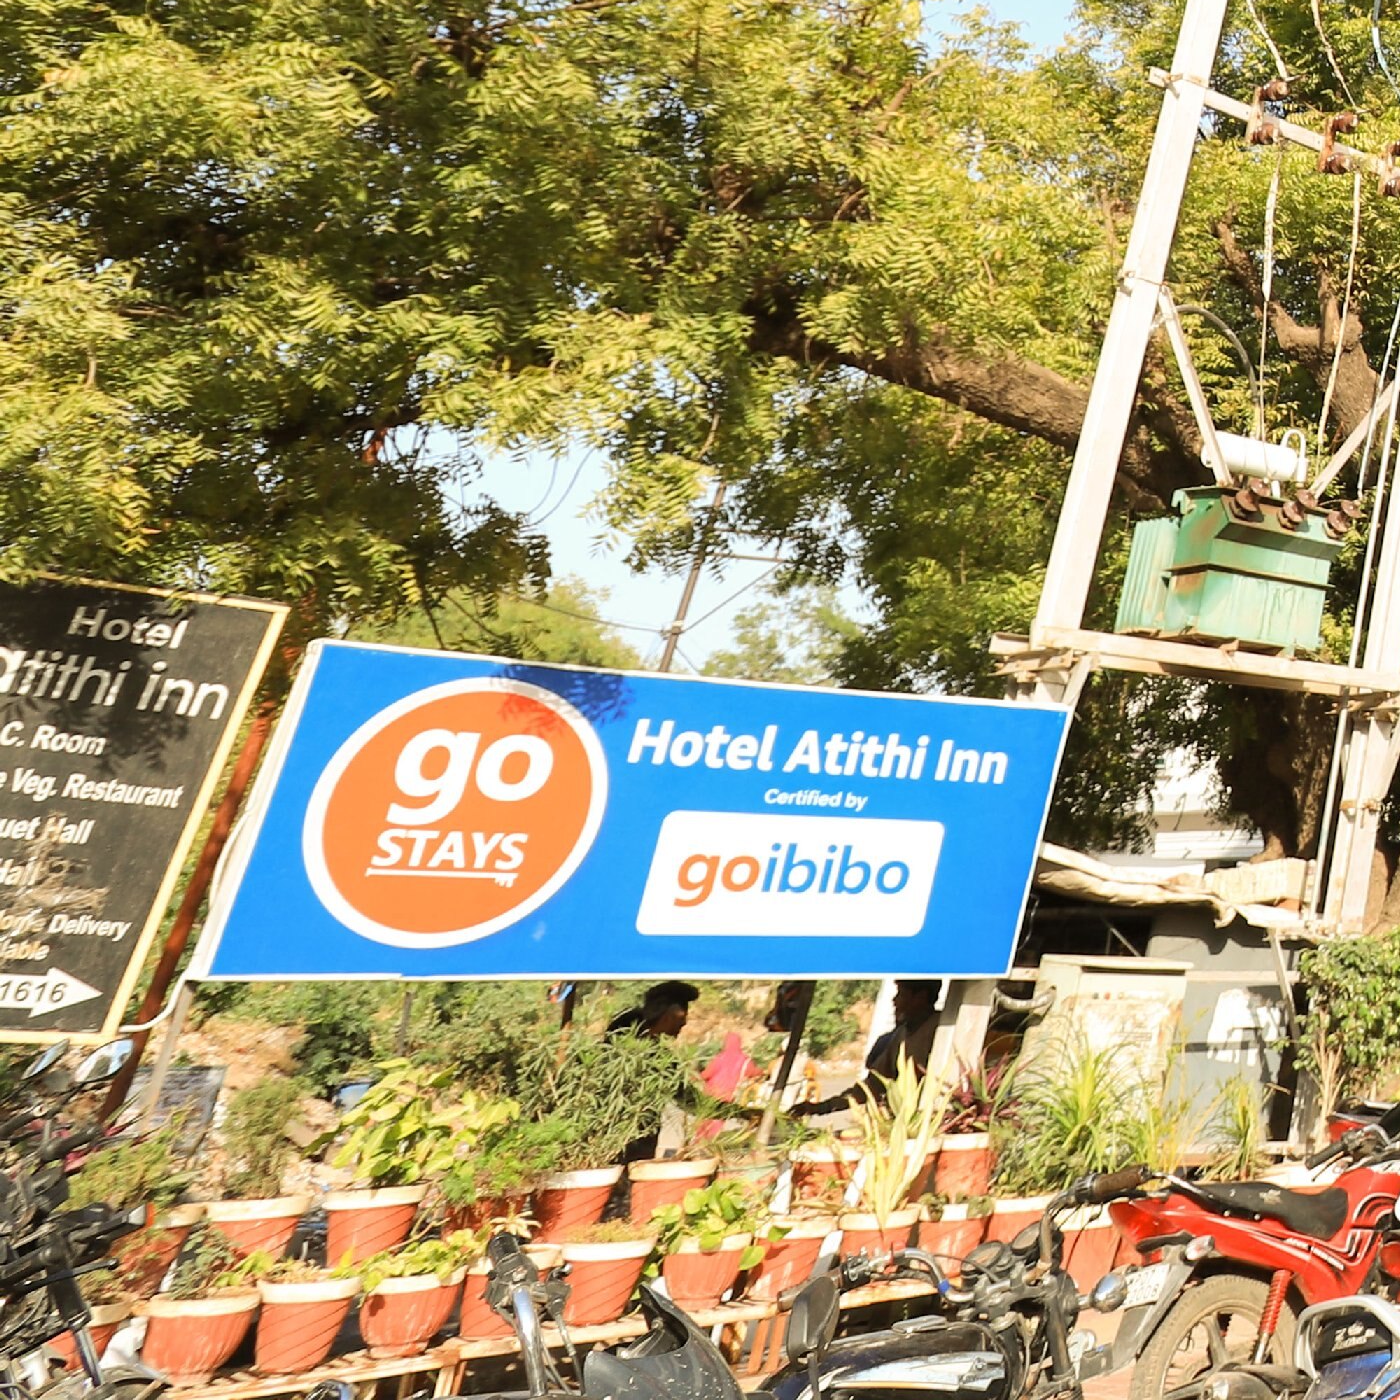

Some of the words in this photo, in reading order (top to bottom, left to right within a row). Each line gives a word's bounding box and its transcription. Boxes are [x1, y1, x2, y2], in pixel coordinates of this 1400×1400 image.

[67, 605, 189, 650] Hotel
[140, 660, 230, 720] inn
[31, 724, 107, 756] Room
[626, 717, 775, 773] Hotel
[782, 728, 929, 780] Atithi
[933, 738, 1009, 786] Inn
[11, 767, 58, 802] Veg.
[61, 773, 184, 809] Restaurant
[385, 722, 555, 827] go
[763, 787, 841, 809] Certified
[844, 792, 869, 812] by
[40, 818, 96, 845] Hall
[371, 829, 528, 871] STAYS
[673, 842, 911, 908] goibibo
[47, 913, 134, 942] Delivery
